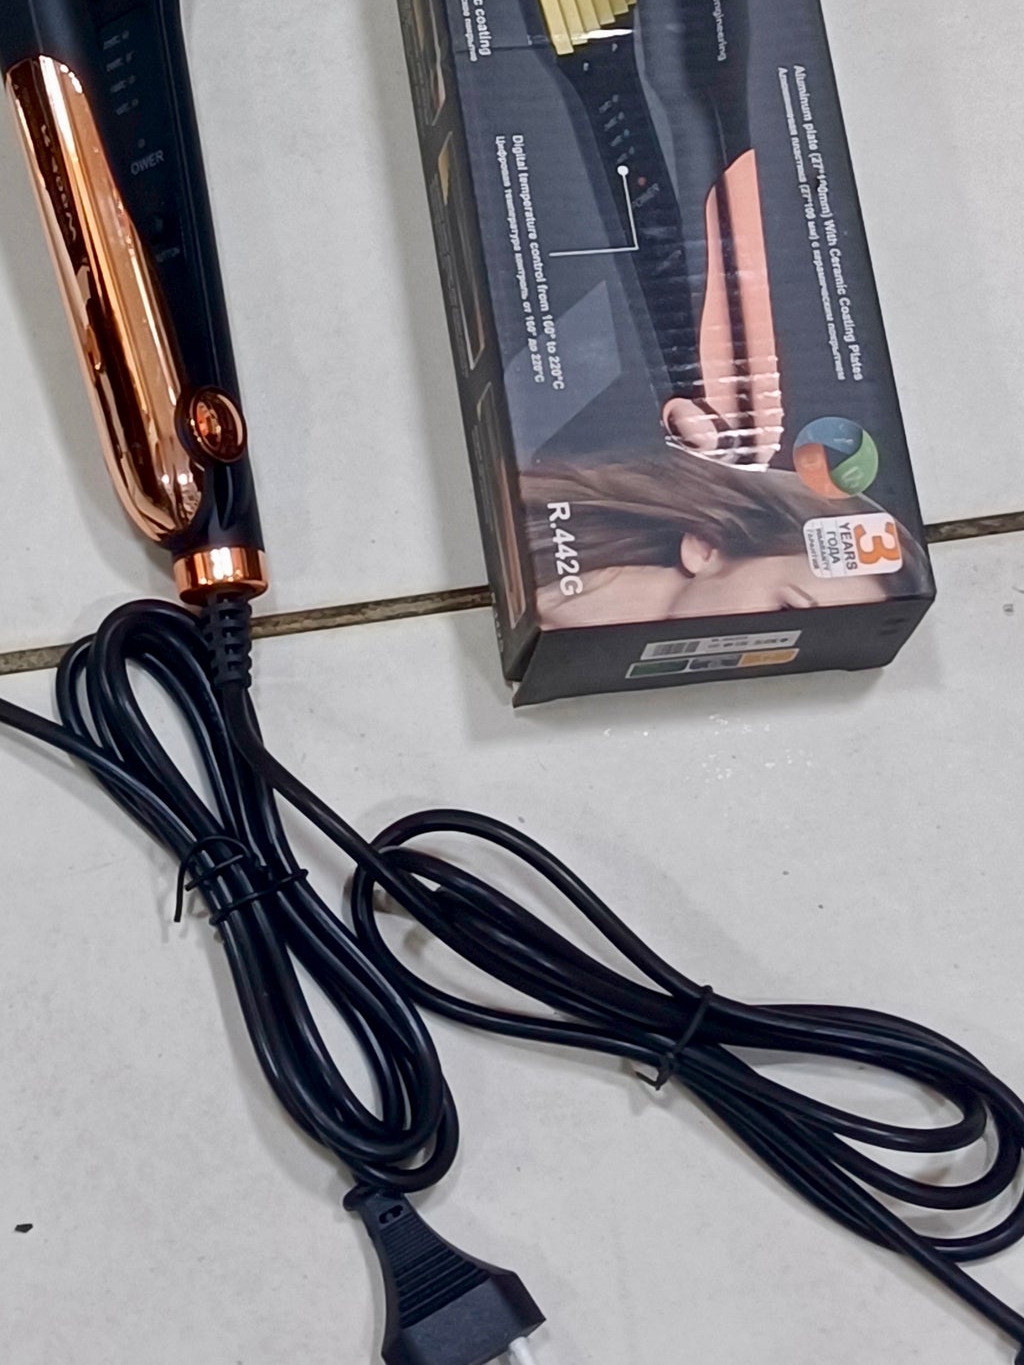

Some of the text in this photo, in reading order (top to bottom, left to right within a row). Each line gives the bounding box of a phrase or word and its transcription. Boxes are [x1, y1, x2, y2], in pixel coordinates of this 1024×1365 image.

[474, 8, 492, 55] coating
[130, 149, 166, 176] OWER
[511, 134, 528, 170] Digital
[517, 172, 537, 240] temperature
[823, 218, 837, 246] With
[528, 241, 546, 282] control
[828, 247, 847, 295] Ceramic
[536, 283, 549, 311] from
[838, 296, 856, 342] Coating
[545, 340, 556, 354] to
[847, 343, 863, 380] Plates
[544, 499, 585, 597] R.442G
[825, 530, 841, 564] ГОДА
[838, 521, 857, 570] YEARS
[852, 518, 900, 566] 3
